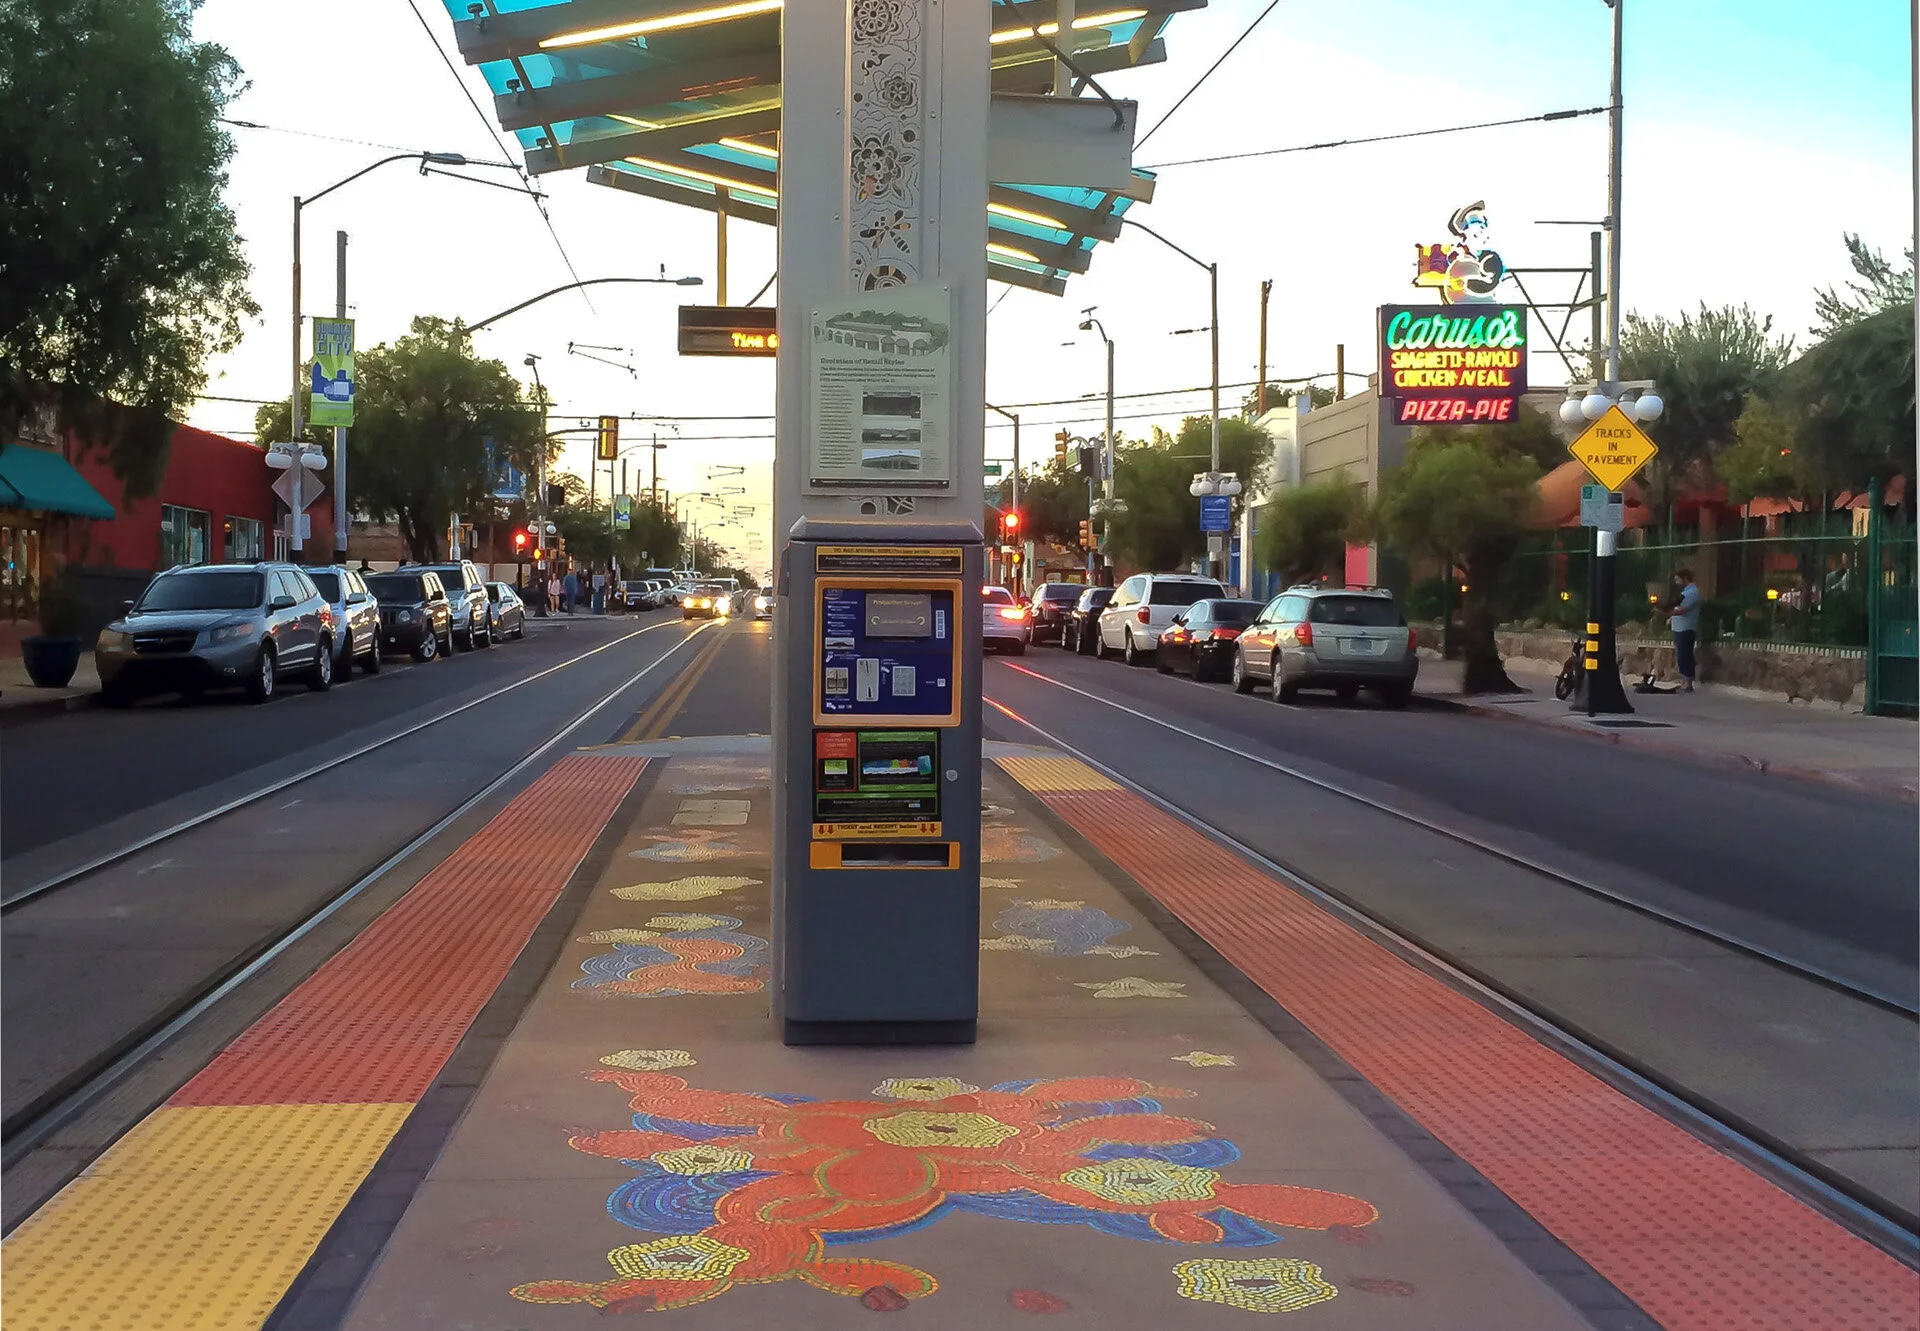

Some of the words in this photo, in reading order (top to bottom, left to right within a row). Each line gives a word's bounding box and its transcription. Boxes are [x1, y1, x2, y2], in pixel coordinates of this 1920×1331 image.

[1387, 310, 1525, 350] Caruso's
[318, 342, 351, 356] CITY
[1401, 399, 1513, 421] PIZZA-PIE
[1595, 428, 1632, 439] TRACKS
[1608, 442, 1618, 451] IN
[1587, 454, 1638, 465] PAVEMENT
